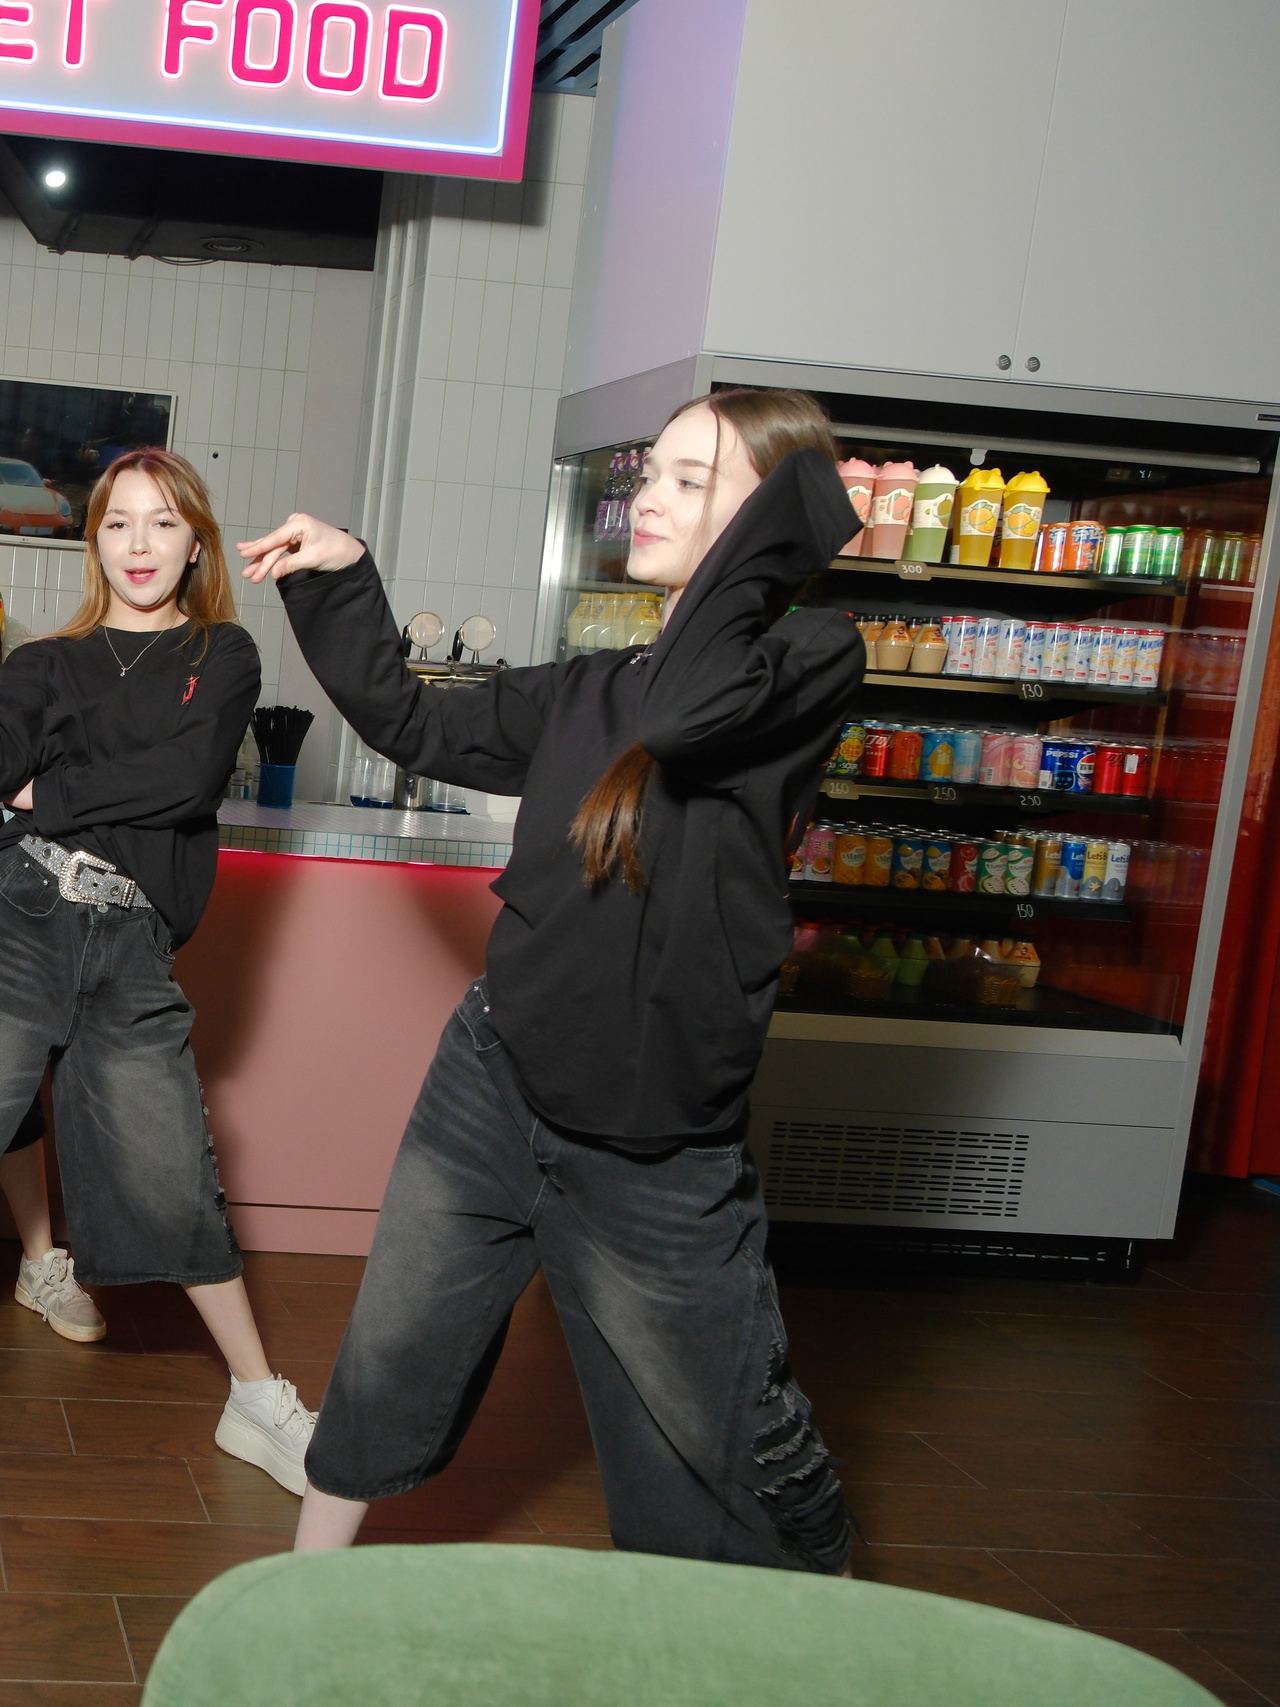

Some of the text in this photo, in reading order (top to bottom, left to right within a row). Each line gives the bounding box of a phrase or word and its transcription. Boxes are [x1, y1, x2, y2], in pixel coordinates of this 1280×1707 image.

[160, 0, 448, 103] FOOD
[901, 564, 923, 574] 300
[1021, 683, 1043, 699] 130
[829, 782, 849, 795] 160
[934, 787, 957, 801] 250
[1020, 795, 1041, 806] 250
[1016, 904, 1034, 918] 150
